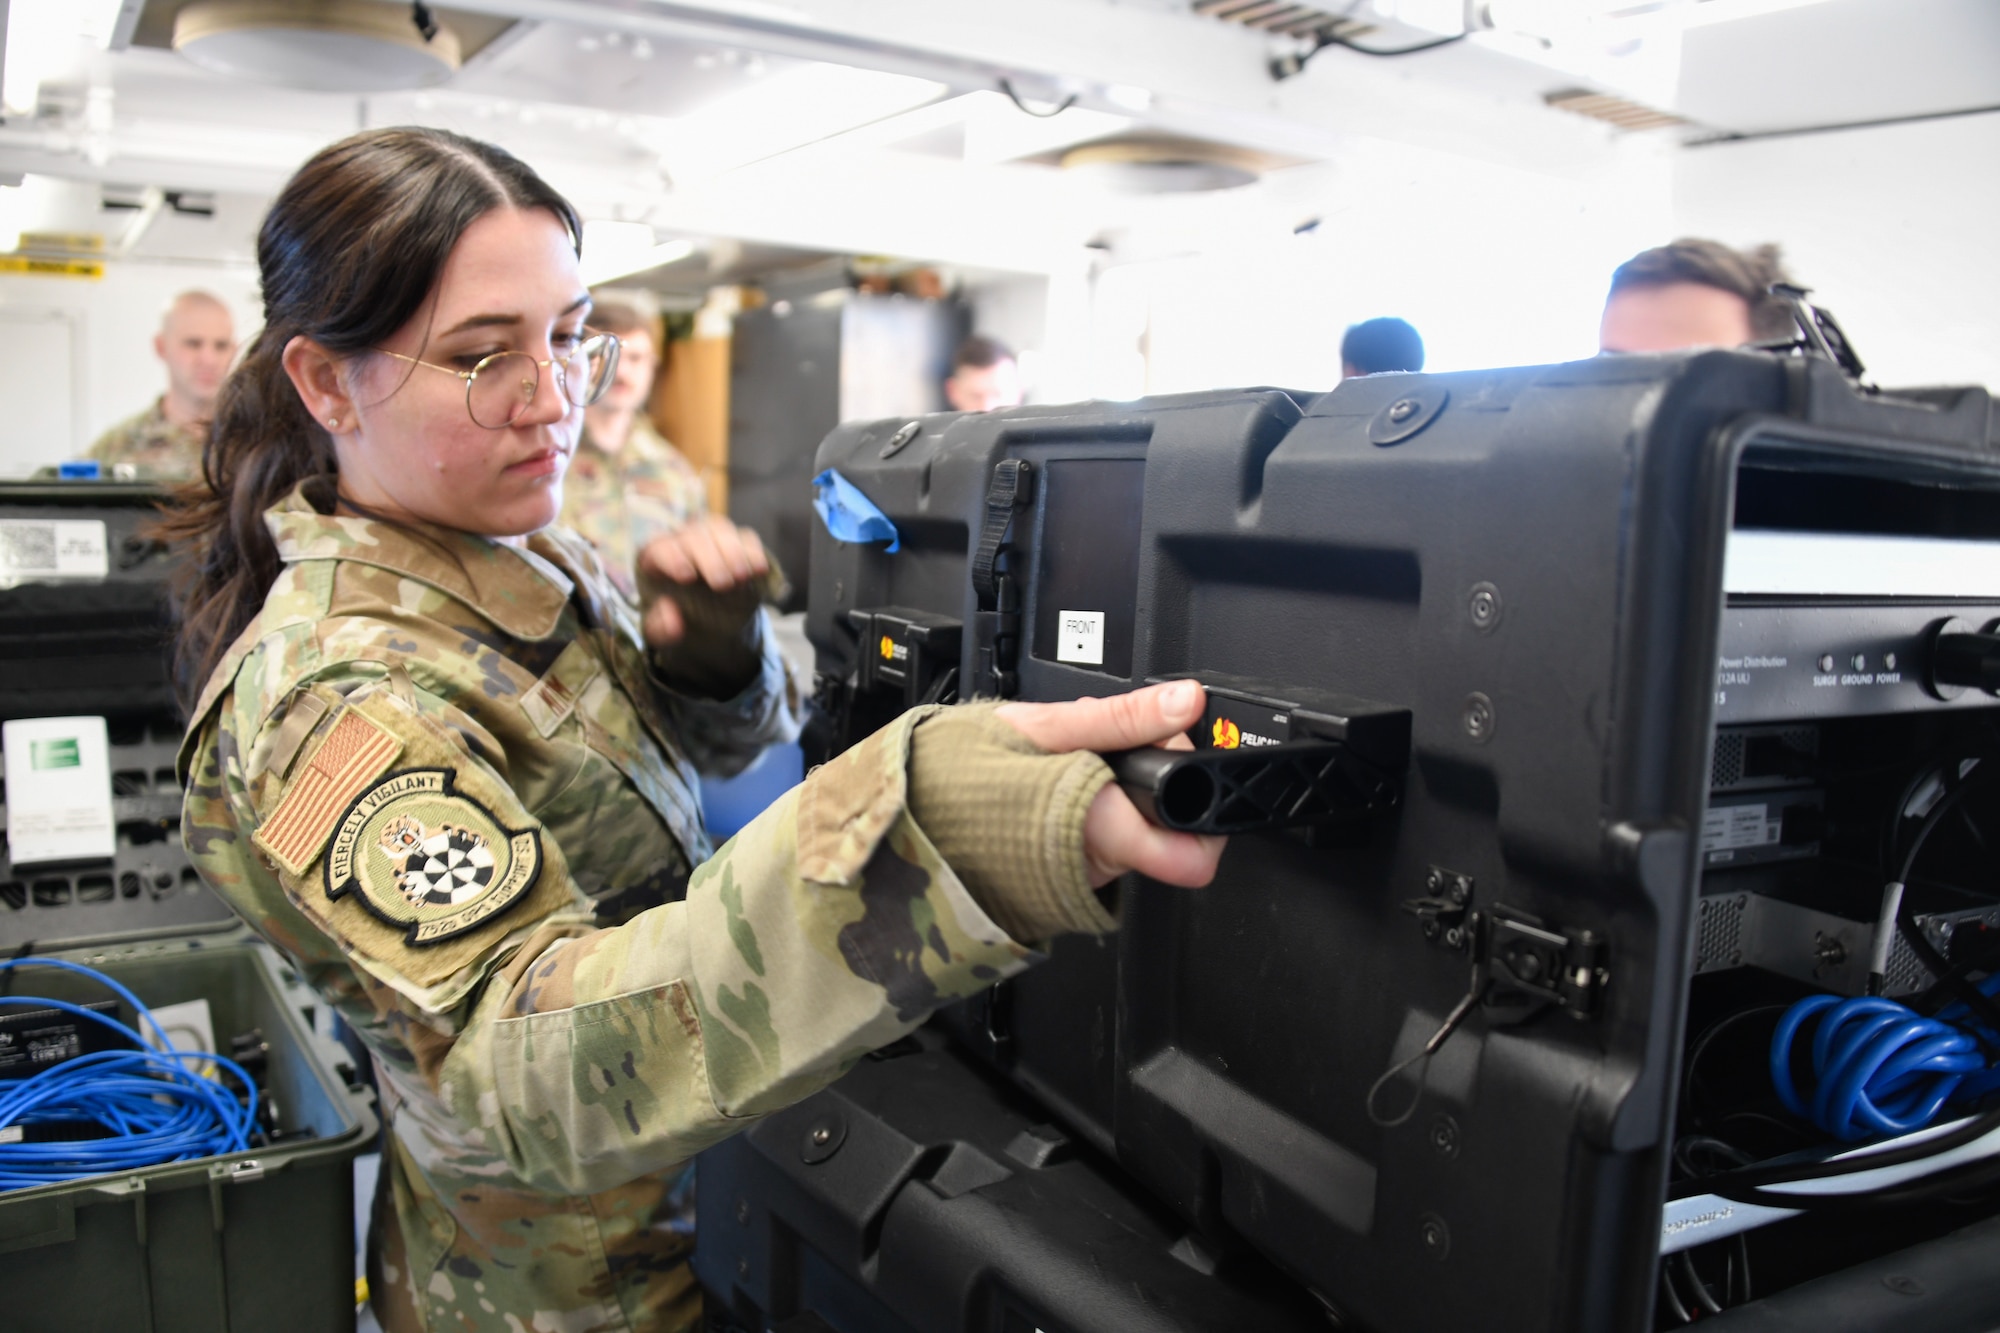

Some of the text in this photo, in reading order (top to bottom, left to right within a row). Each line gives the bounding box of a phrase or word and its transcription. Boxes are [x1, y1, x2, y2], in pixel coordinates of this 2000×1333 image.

[1066, 619, 1096, 634] FRONT
[1743, 655, 1787, 668] Distribution
[1813, 672, 1901, 687] SURGE GROUND POWER
[335, 776, 436, 879] FIERCELY VIGILANT
